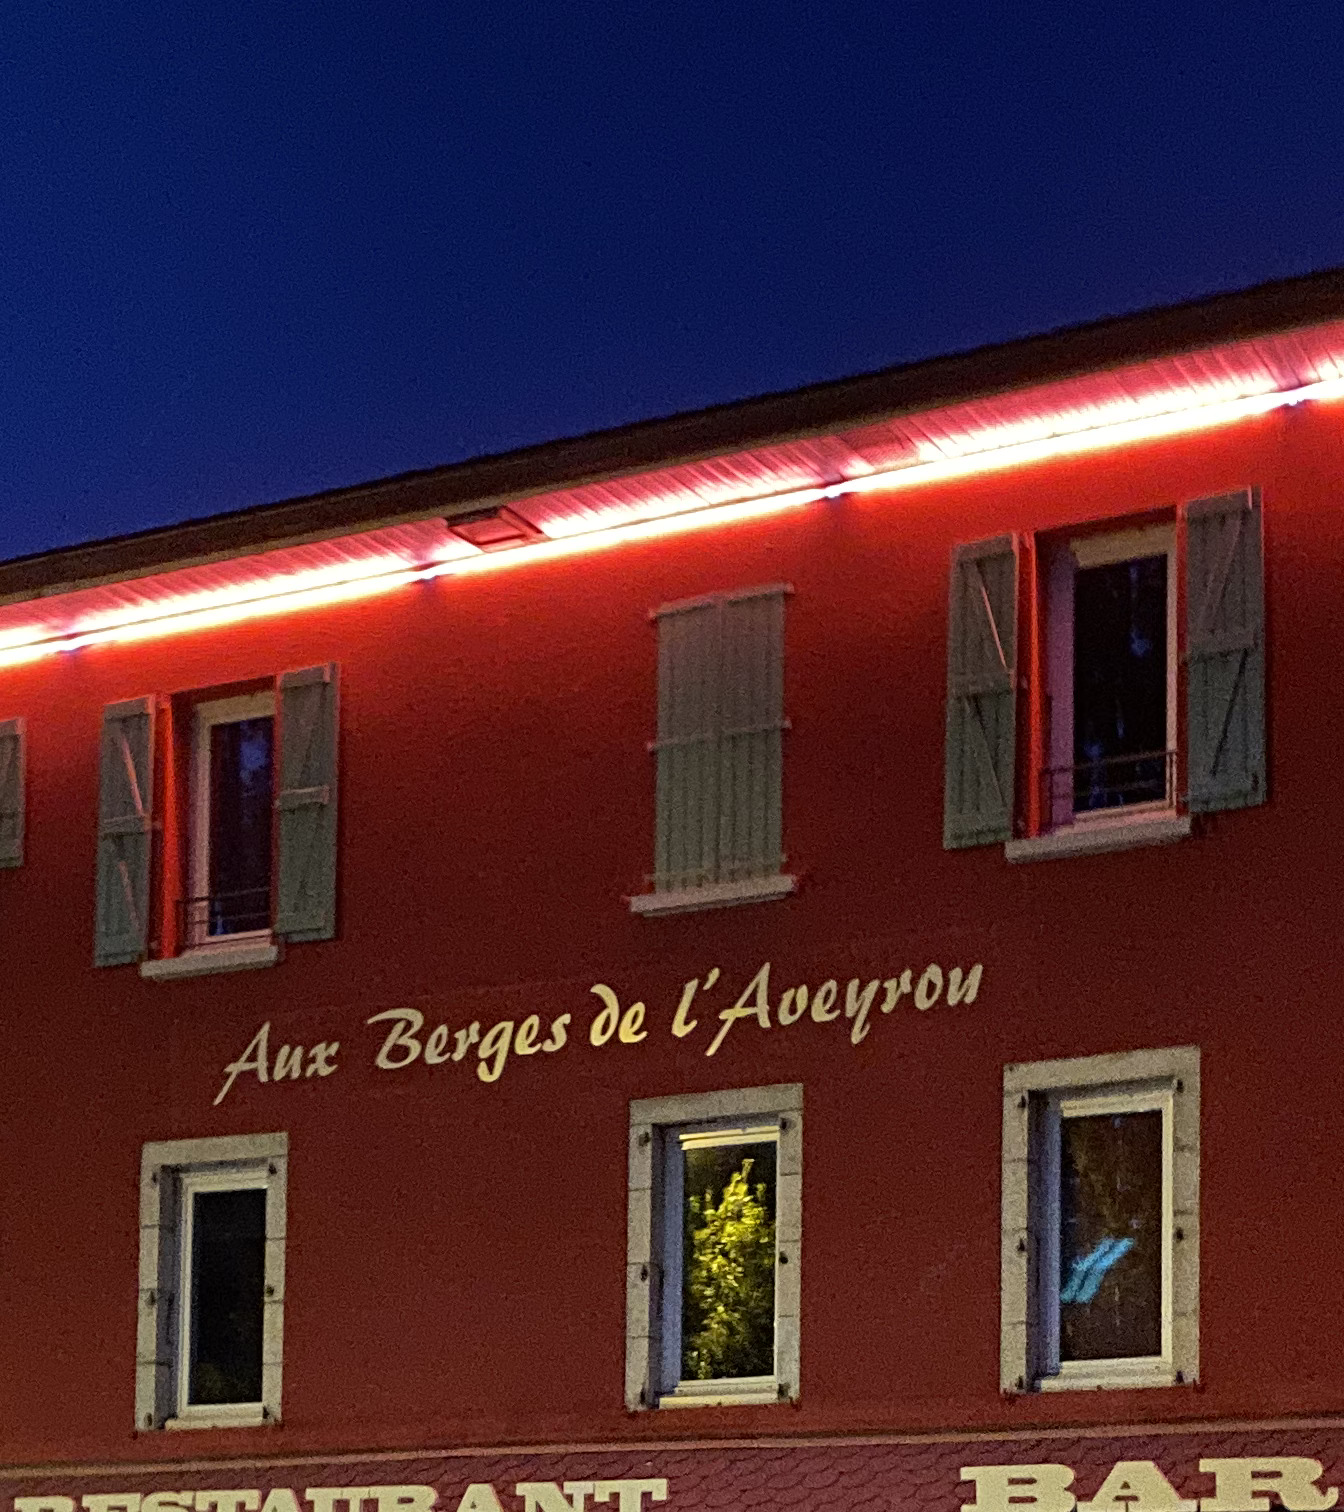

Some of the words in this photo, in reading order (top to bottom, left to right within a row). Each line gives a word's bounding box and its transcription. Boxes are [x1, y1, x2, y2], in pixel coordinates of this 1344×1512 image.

[213, 1022, 340, 1106] Aux
[367, 1008, 571, 1082] Berges
[588, 984, 648, 1046] de
